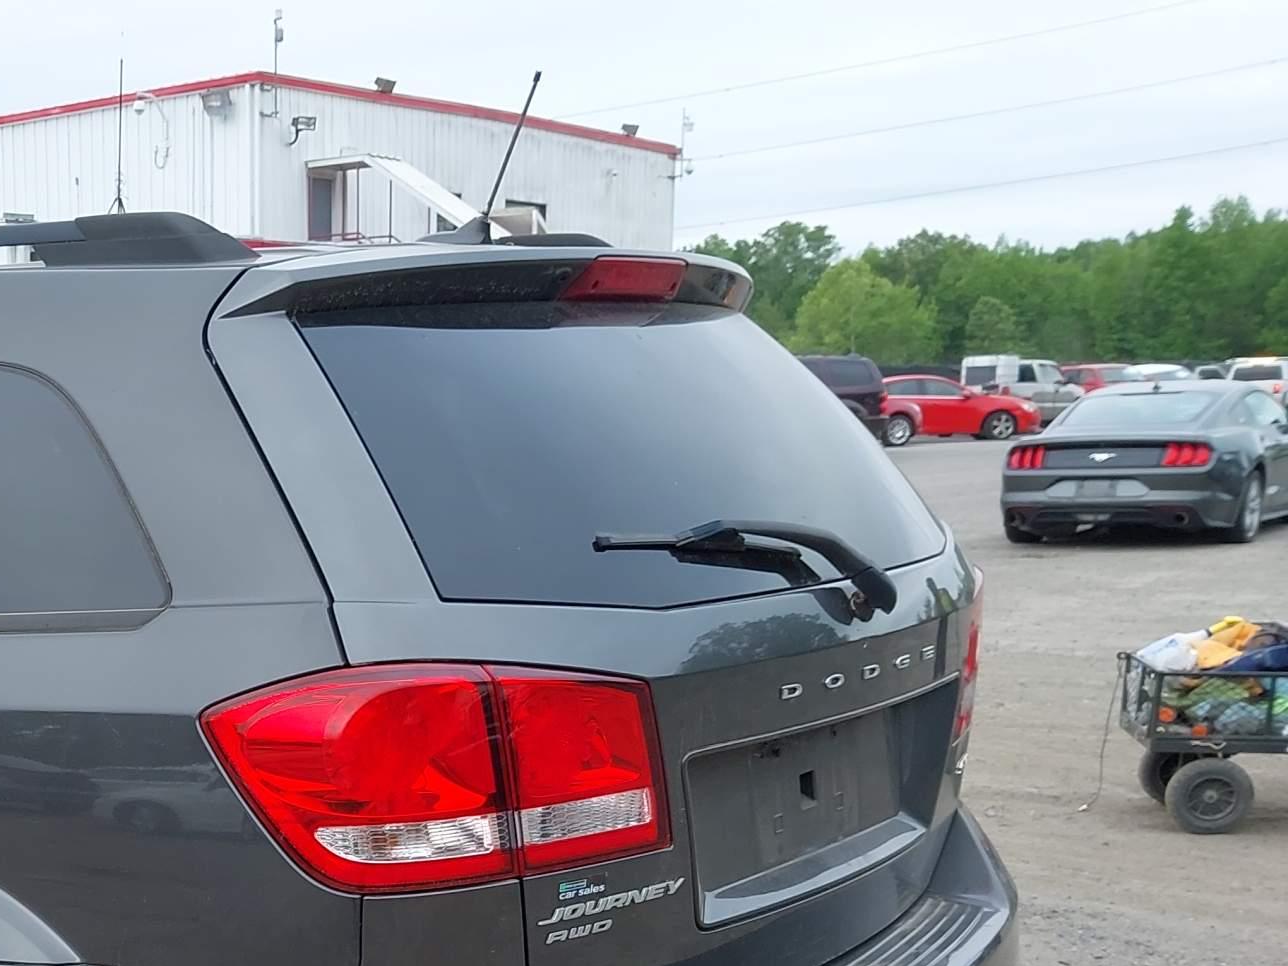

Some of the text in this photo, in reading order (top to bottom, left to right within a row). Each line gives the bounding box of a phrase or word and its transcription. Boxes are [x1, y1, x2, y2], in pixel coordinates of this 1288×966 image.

[780, 645, 936, 700] DODGE
[537, 876, 687, 926] JOURNEY
[559, 891, 578, 901] car
[579, 884, 606, 897] sales
[545, 919, 613, 945] AWD
